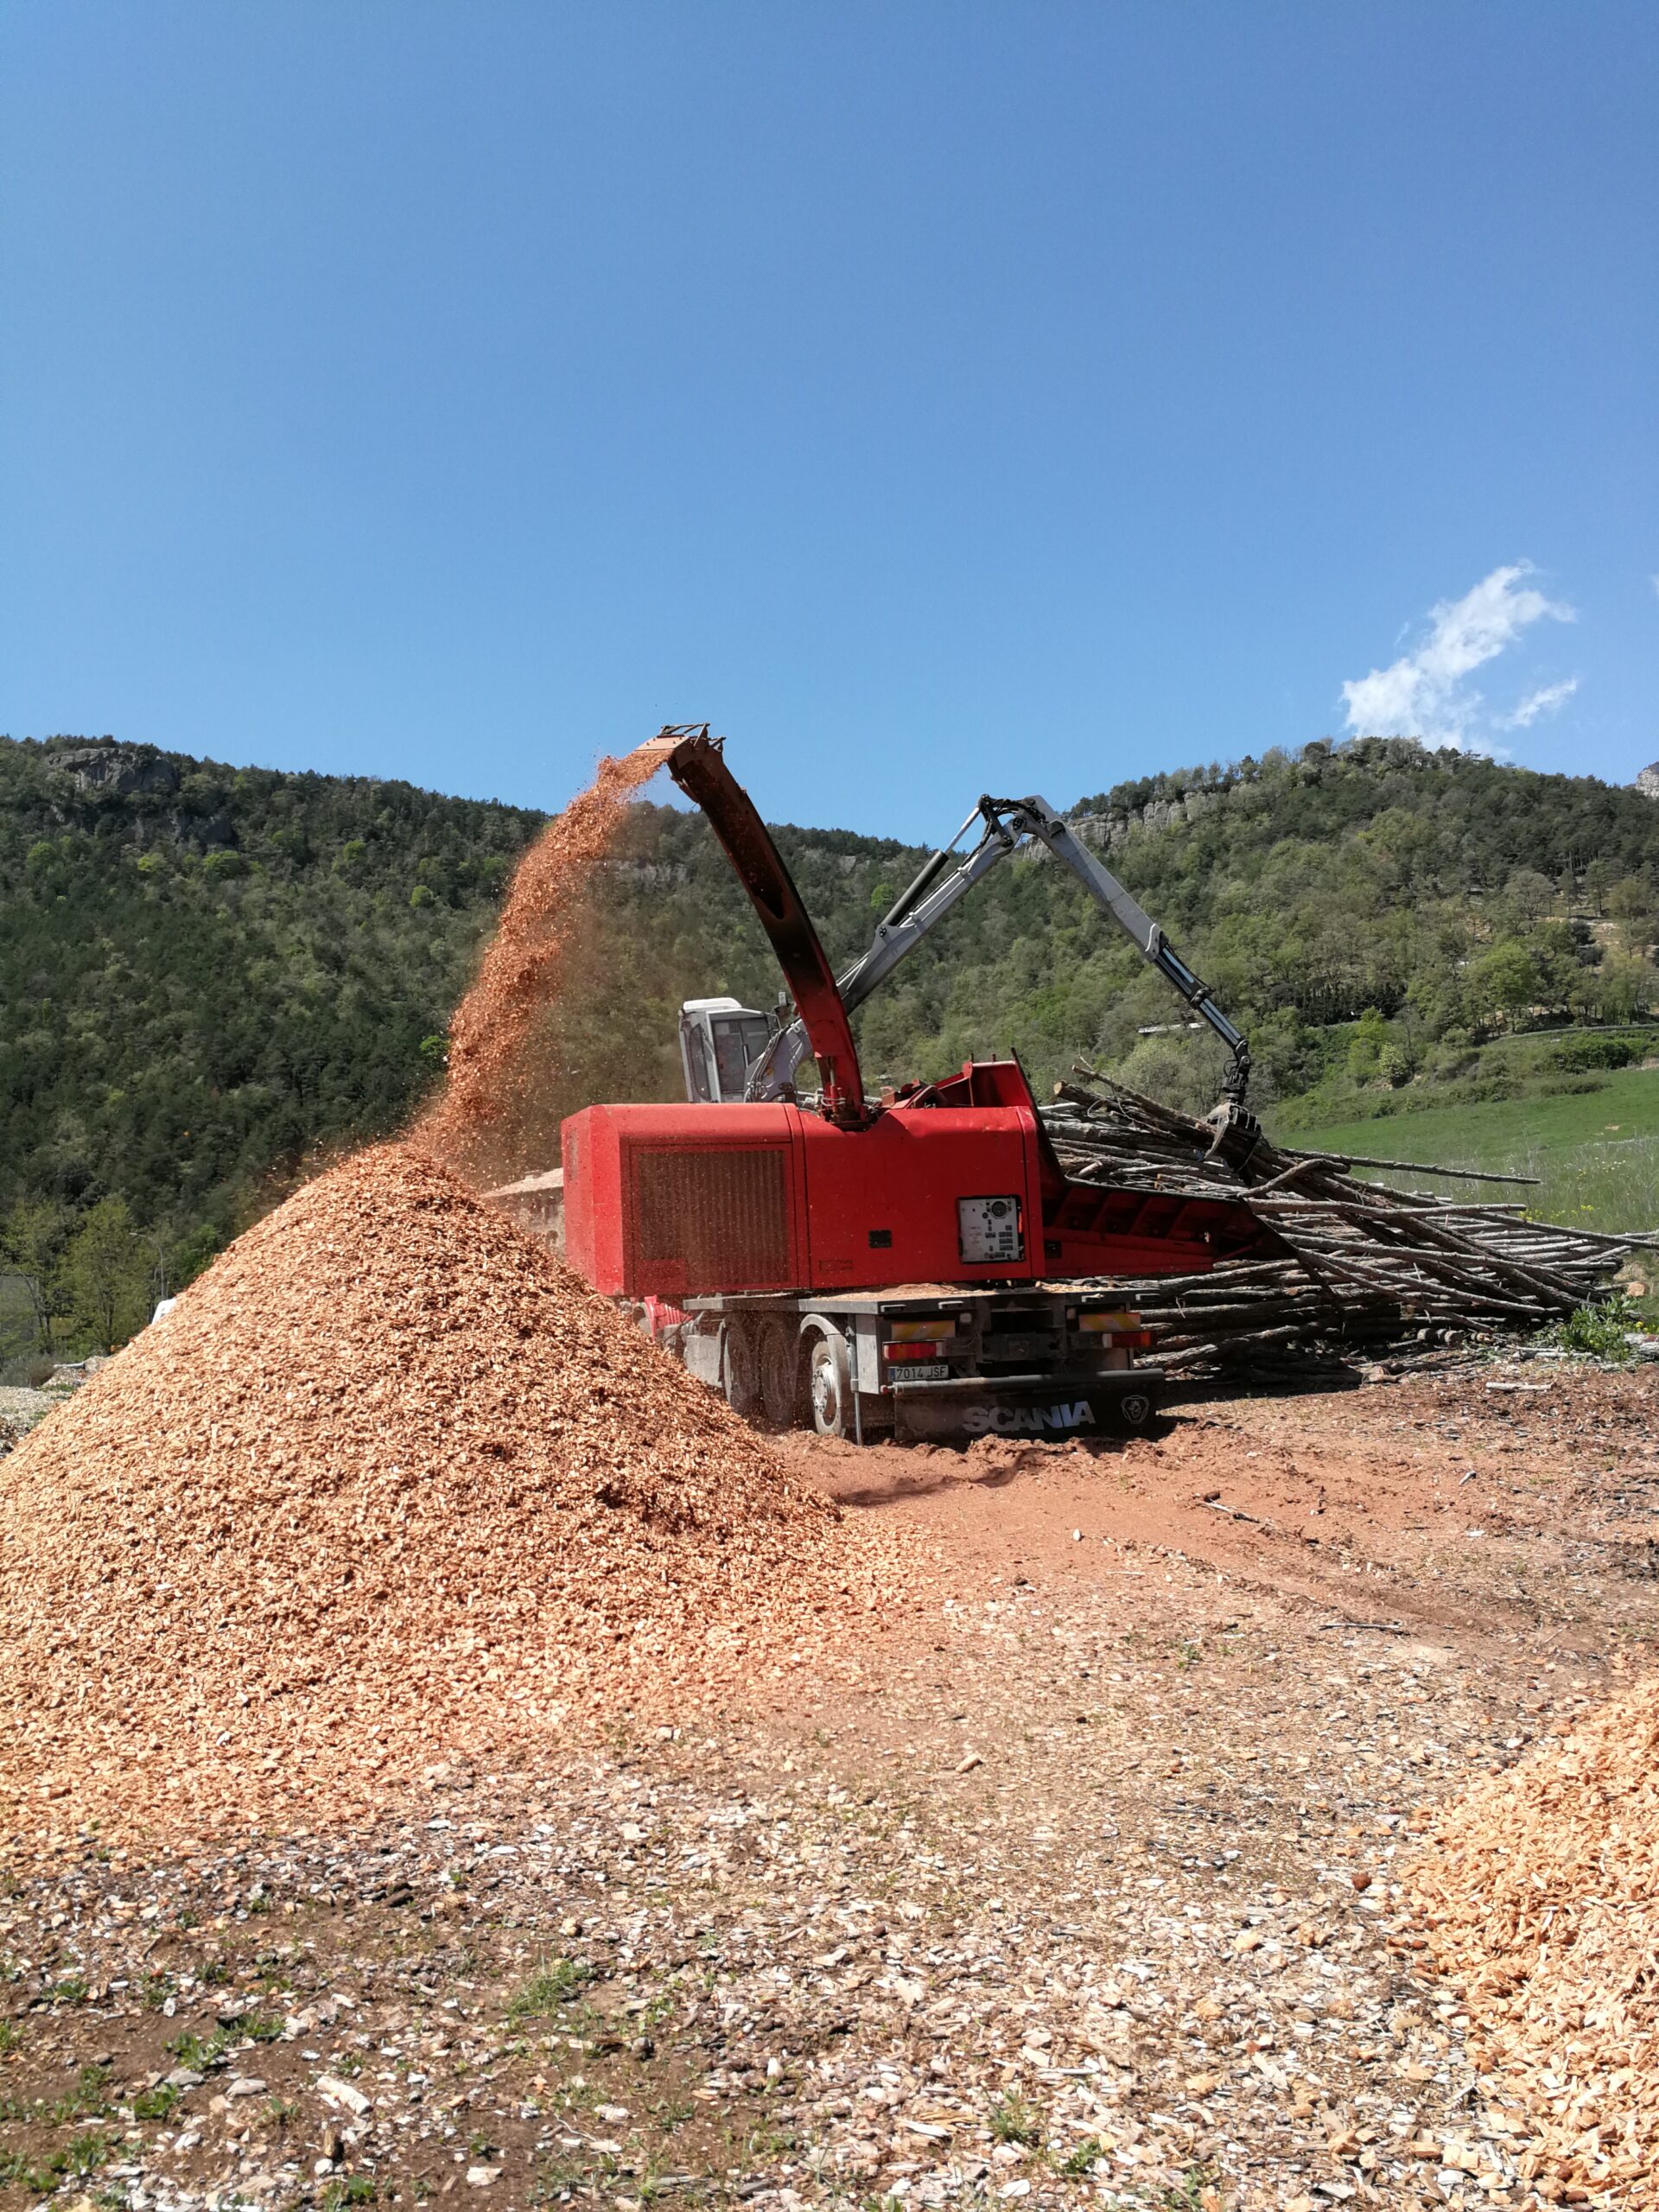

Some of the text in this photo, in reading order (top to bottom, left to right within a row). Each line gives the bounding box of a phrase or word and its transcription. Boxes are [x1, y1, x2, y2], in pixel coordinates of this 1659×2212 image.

[896, 1368, 924, 1379] 7014
[927, 1366, 947, 1377] JSF
[963, 1401, 1096, 1432] SCANIA
